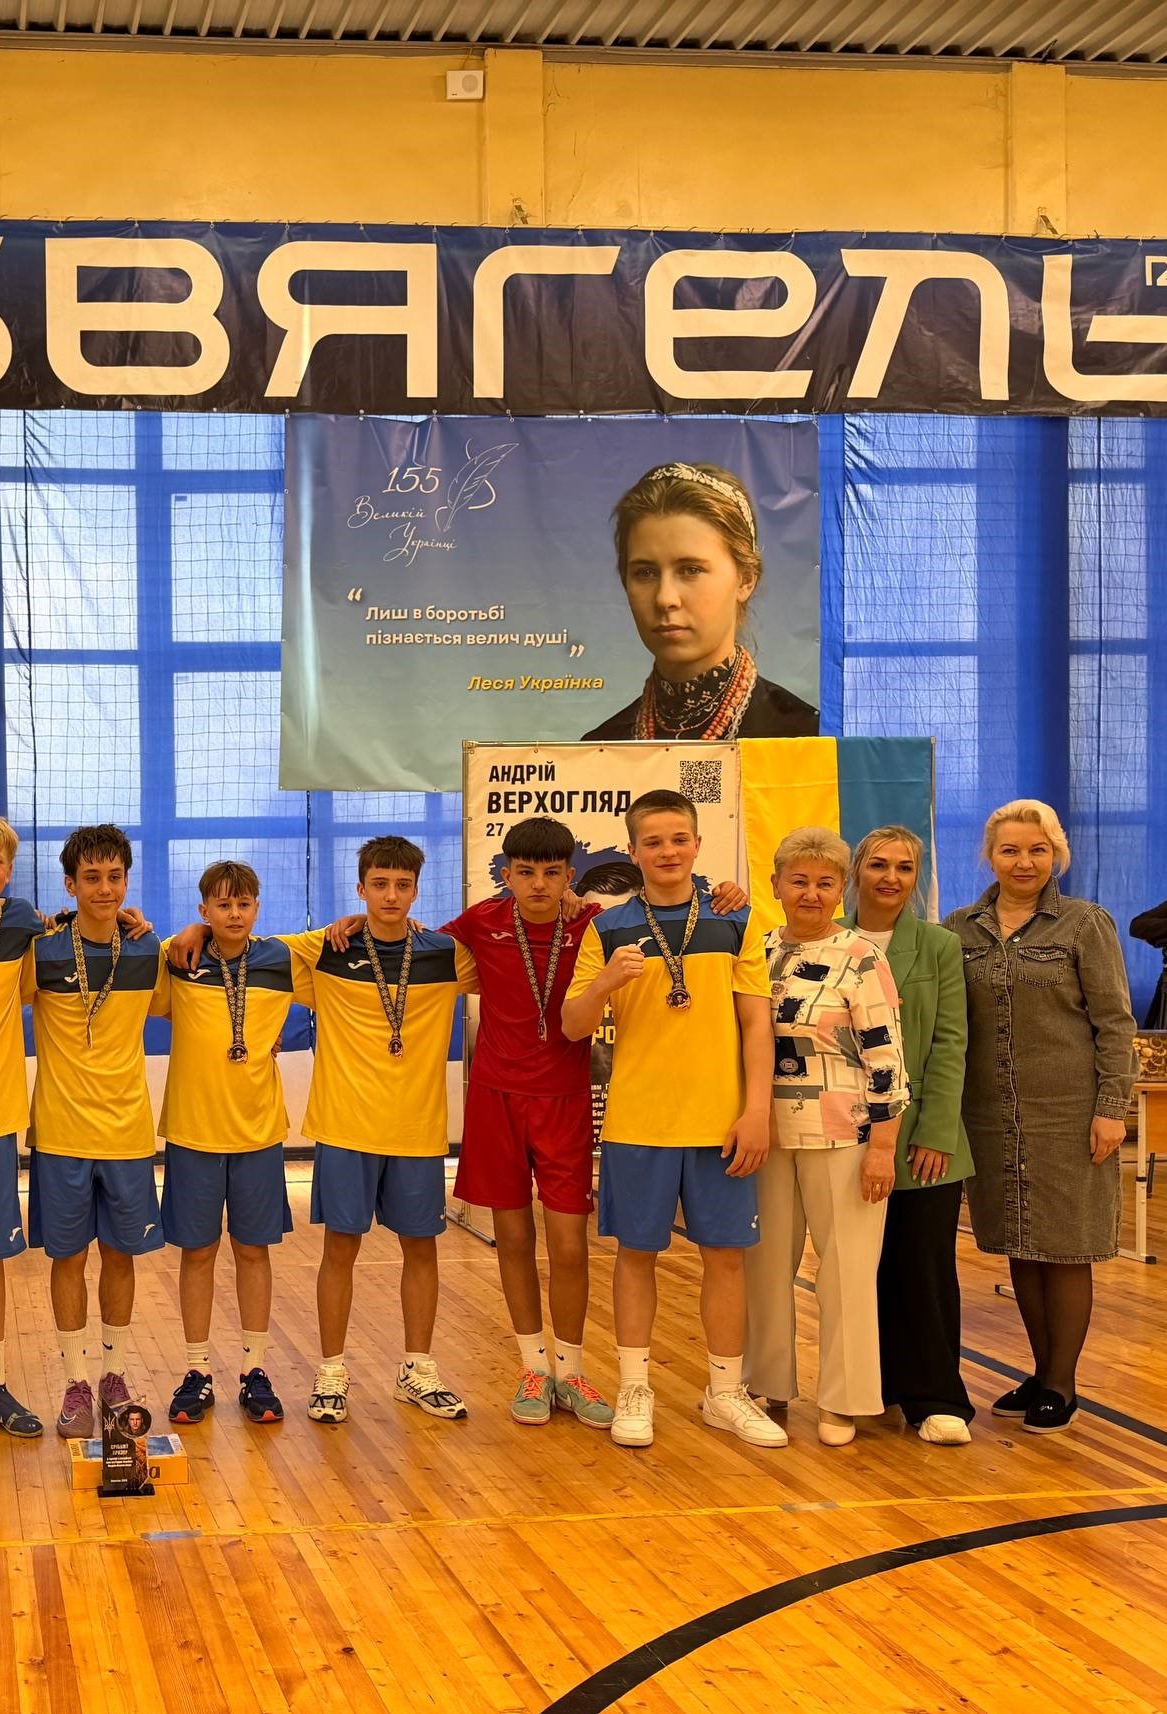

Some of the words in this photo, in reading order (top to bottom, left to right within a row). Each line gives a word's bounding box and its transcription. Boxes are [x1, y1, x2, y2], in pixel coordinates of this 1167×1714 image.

[382, 466, 442, 494] 155
[347, 495, 427, 528] Великій
[383, 522, 457, 567] Українці
[365, 606, 409, 621] Лиш
[413, 608, 422, 619] в
[426, 605, 505, 624] боротьбі
[366, 629, 462, 645] пізнається
[466, 631, 520, 645] велич
[524, 628, 568, 647] душі
[467, 675, 515, 691] Леся
[519, 673, 604, 694] Українка
[488, 761, 556, 785] АНДРІЙ
[487, 790, 632, 817] ВЕРХОГЛЯД
[486, 822, 505, 837] 27
